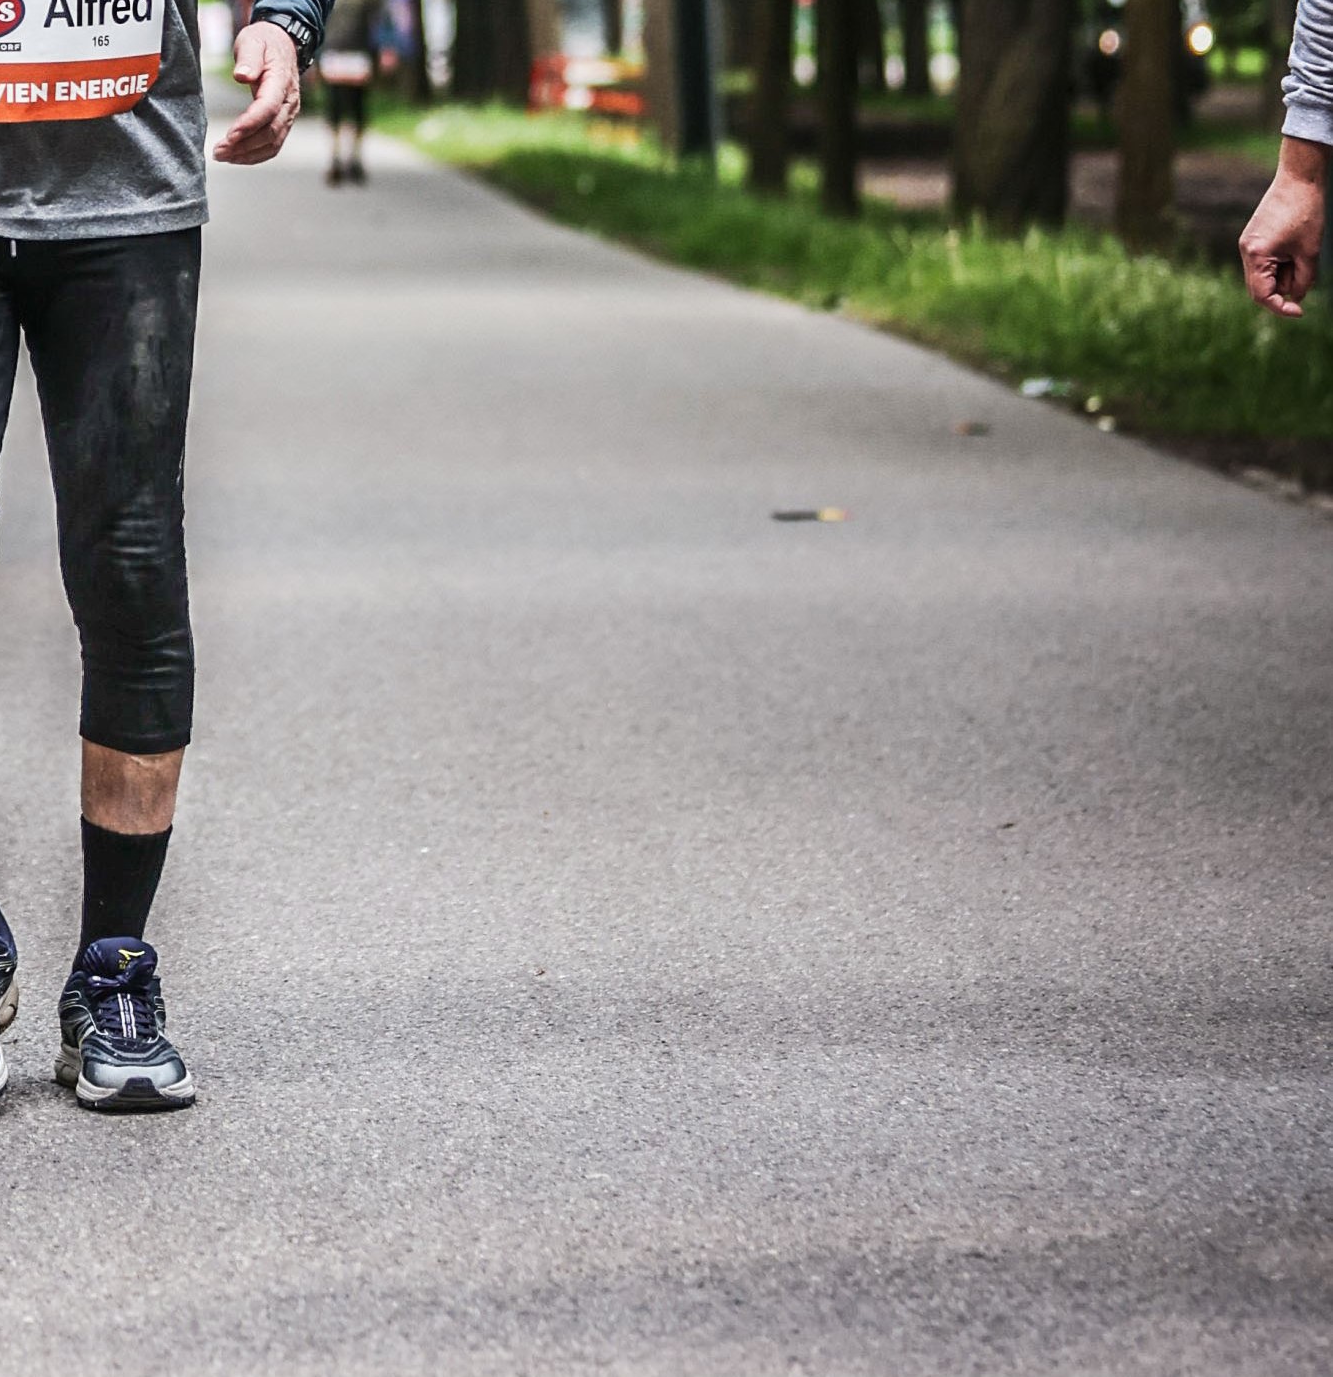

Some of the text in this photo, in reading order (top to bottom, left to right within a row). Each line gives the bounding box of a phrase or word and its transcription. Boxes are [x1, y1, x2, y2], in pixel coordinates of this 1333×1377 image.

[0, 43, 21, 51] ORF
[91, 35, 110, 48] 165
[54, 73, 150, 102] ENERGIE
